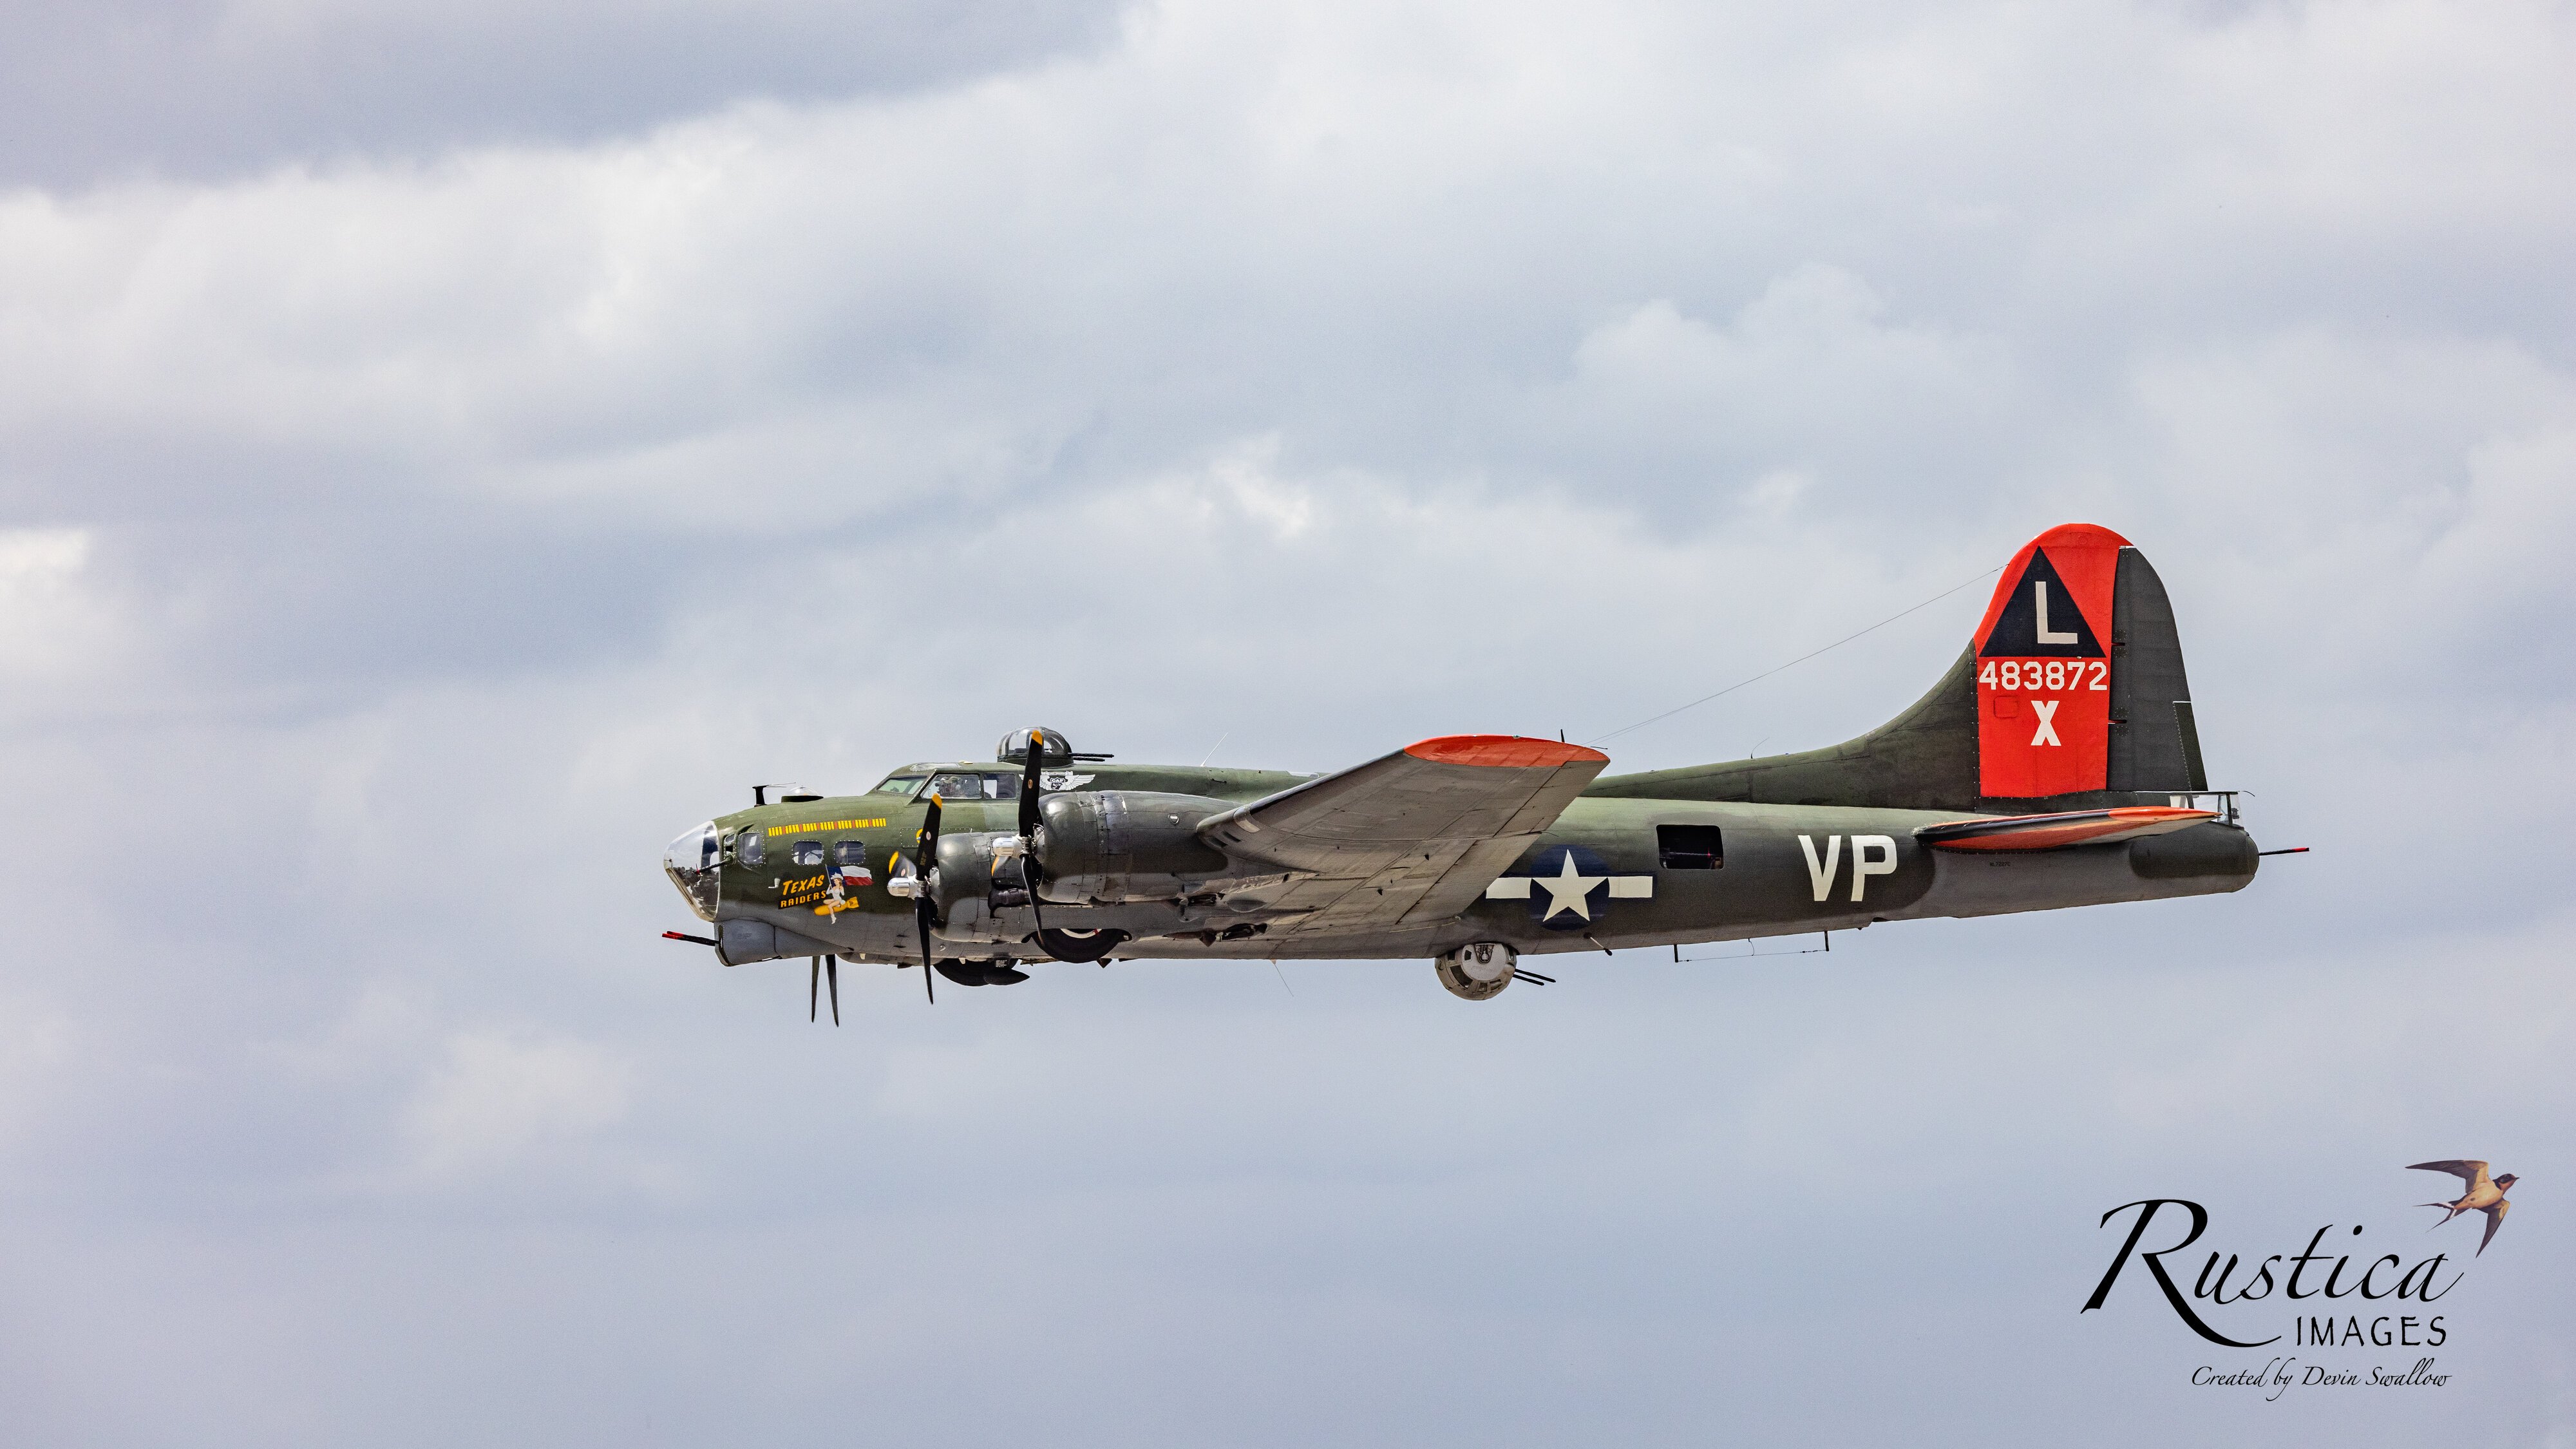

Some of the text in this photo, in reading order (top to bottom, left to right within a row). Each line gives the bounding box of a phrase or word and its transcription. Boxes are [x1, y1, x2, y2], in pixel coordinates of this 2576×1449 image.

[2035, 581, 2078, 644] L
[1979, 661, 2108, 690] 483872
[2031, 700, 2061, 746] X
[782, 875, 825, 896] TEXAS
[1797, 835, 1897, 902] VP
[781, 890, 826, 907] RAIDERS
